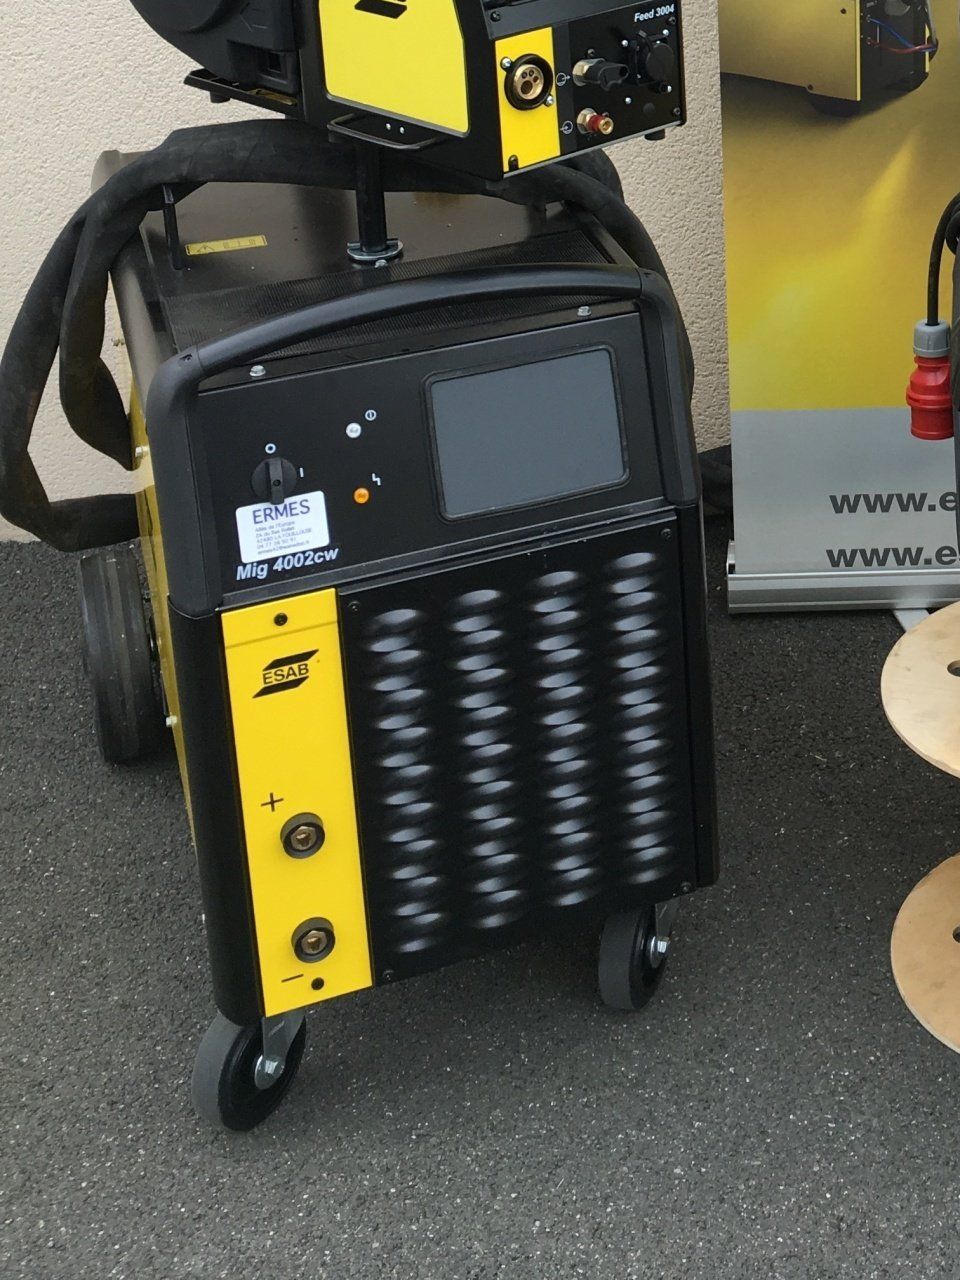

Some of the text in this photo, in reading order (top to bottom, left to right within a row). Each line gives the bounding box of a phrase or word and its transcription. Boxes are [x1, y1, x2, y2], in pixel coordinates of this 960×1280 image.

[634, 3, 675, 23] Feed 3004
[252, 498, 310, 525] ERMES
[236, 562, 269, 581] Mig
[272, 548, 340, 572] 4002cw
[262, 663, 310, 685] ESAB
